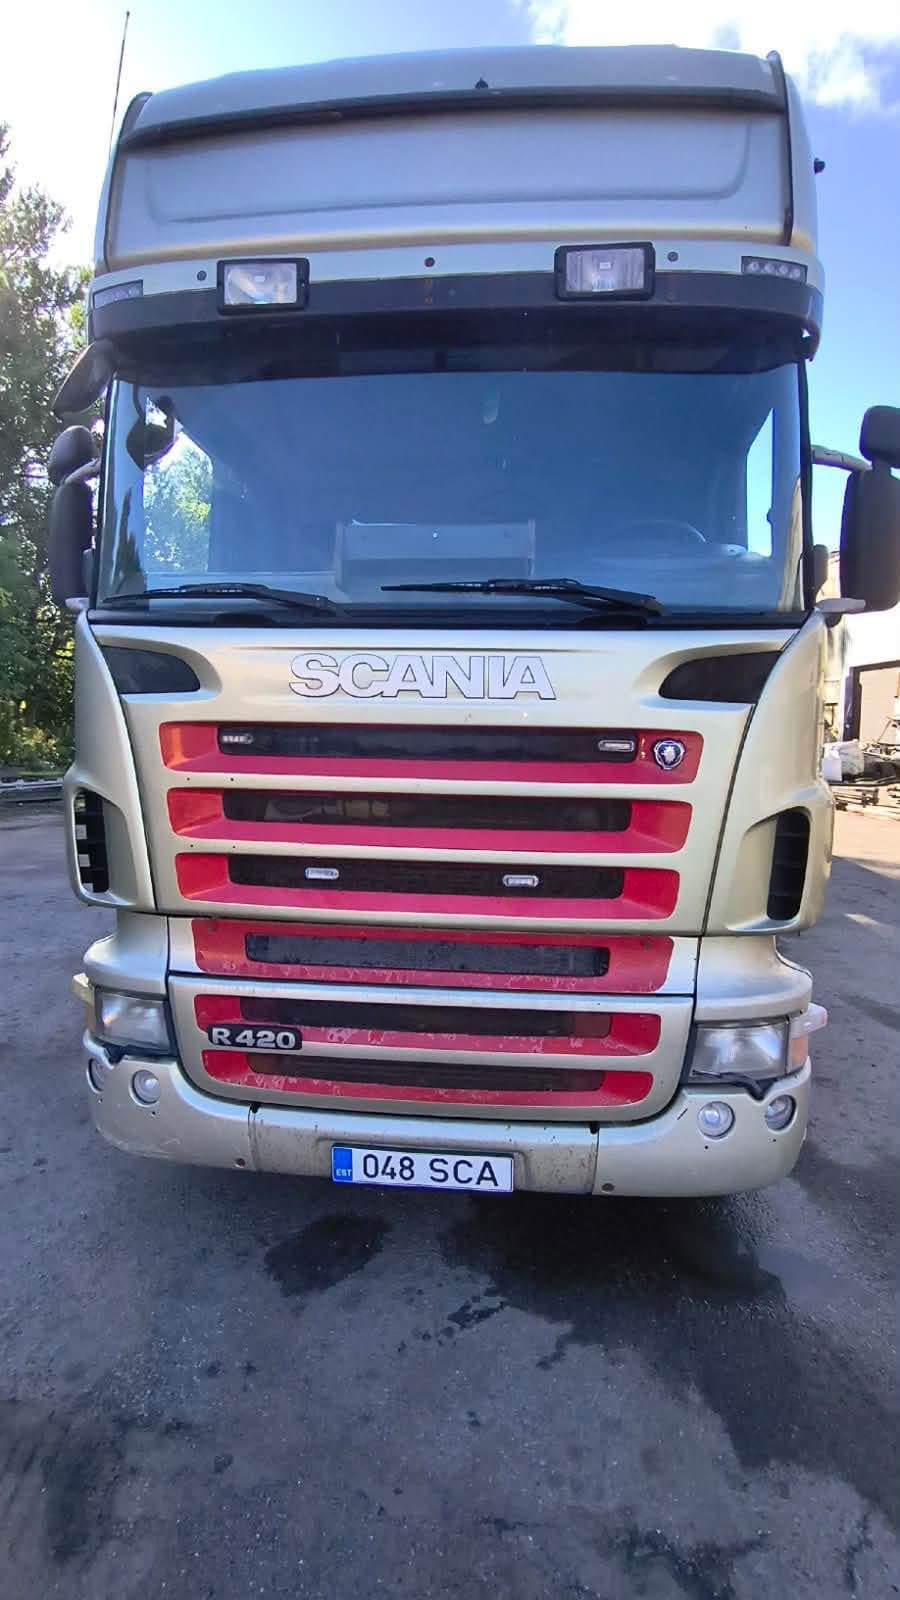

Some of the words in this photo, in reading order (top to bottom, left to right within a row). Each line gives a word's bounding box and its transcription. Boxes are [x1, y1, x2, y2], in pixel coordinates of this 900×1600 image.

[289, 653, 557, 700] SCANIA
[212, 1027, 232, 1045] R
[235, 1029, 296, 1049] 420
[335, 1168, 352, 1177] EST
[362, 1153, 415, 1181] 048
[429, 1158, 499, 1187] SCA
